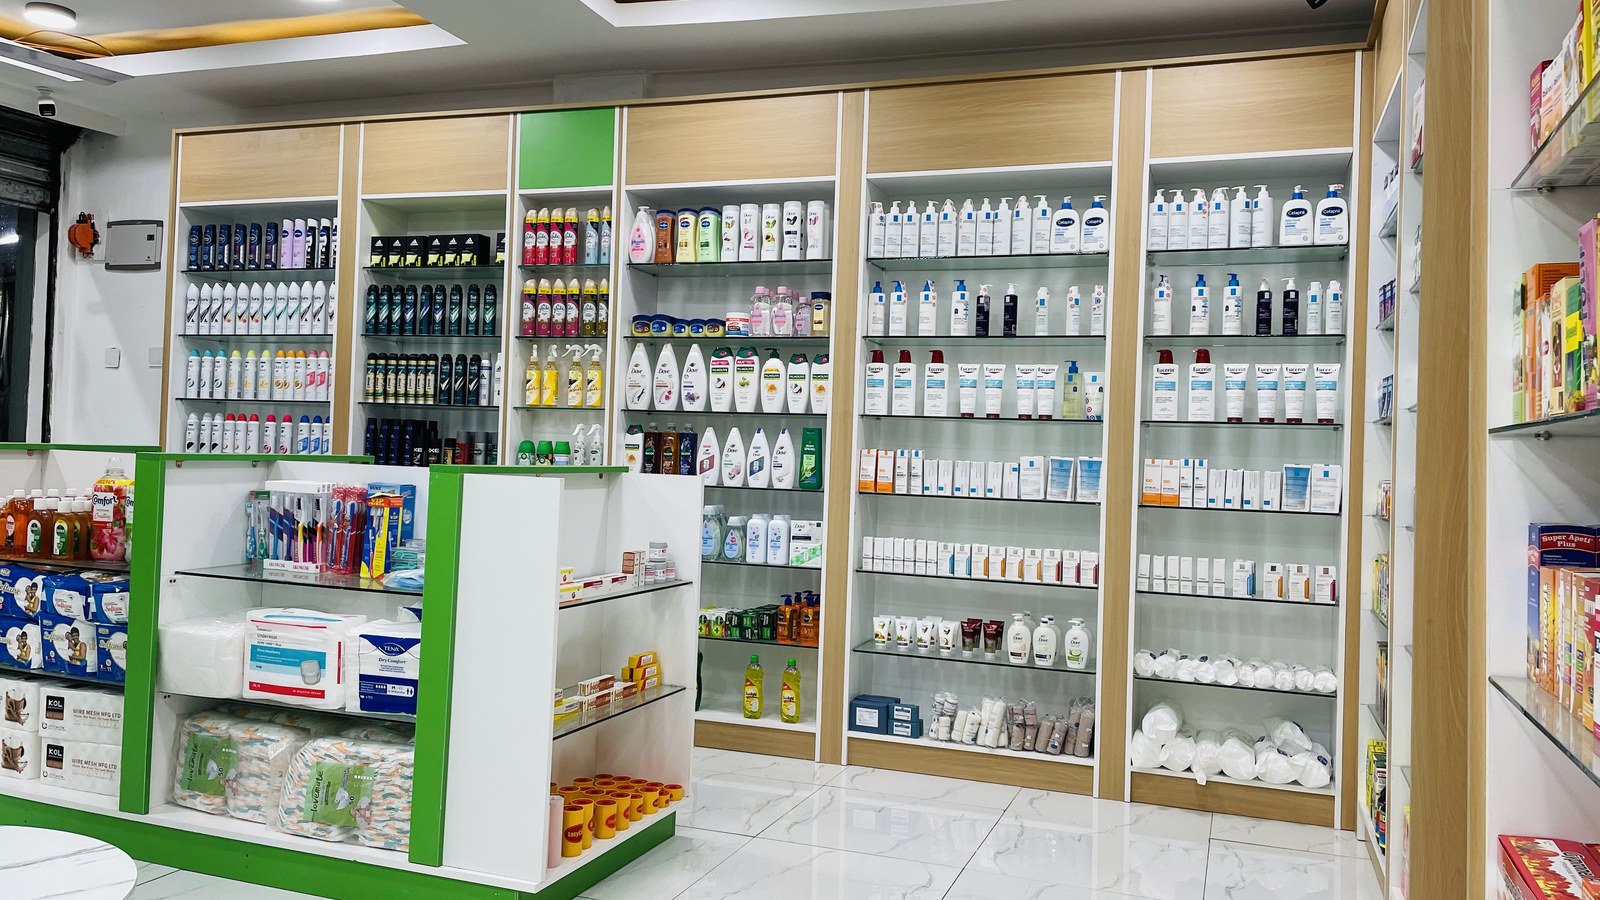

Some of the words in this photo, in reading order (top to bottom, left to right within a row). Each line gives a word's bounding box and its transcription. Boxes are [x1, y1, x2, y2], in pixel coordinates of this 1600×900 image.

[92, 493, 118, 506] Comfort
[1568, 534, 1590, 544] Apeti
[48, 699, 63, 707] KOL
[48, 748, 62, 757] KOL
[311, 770, 324, 813] lovemate
